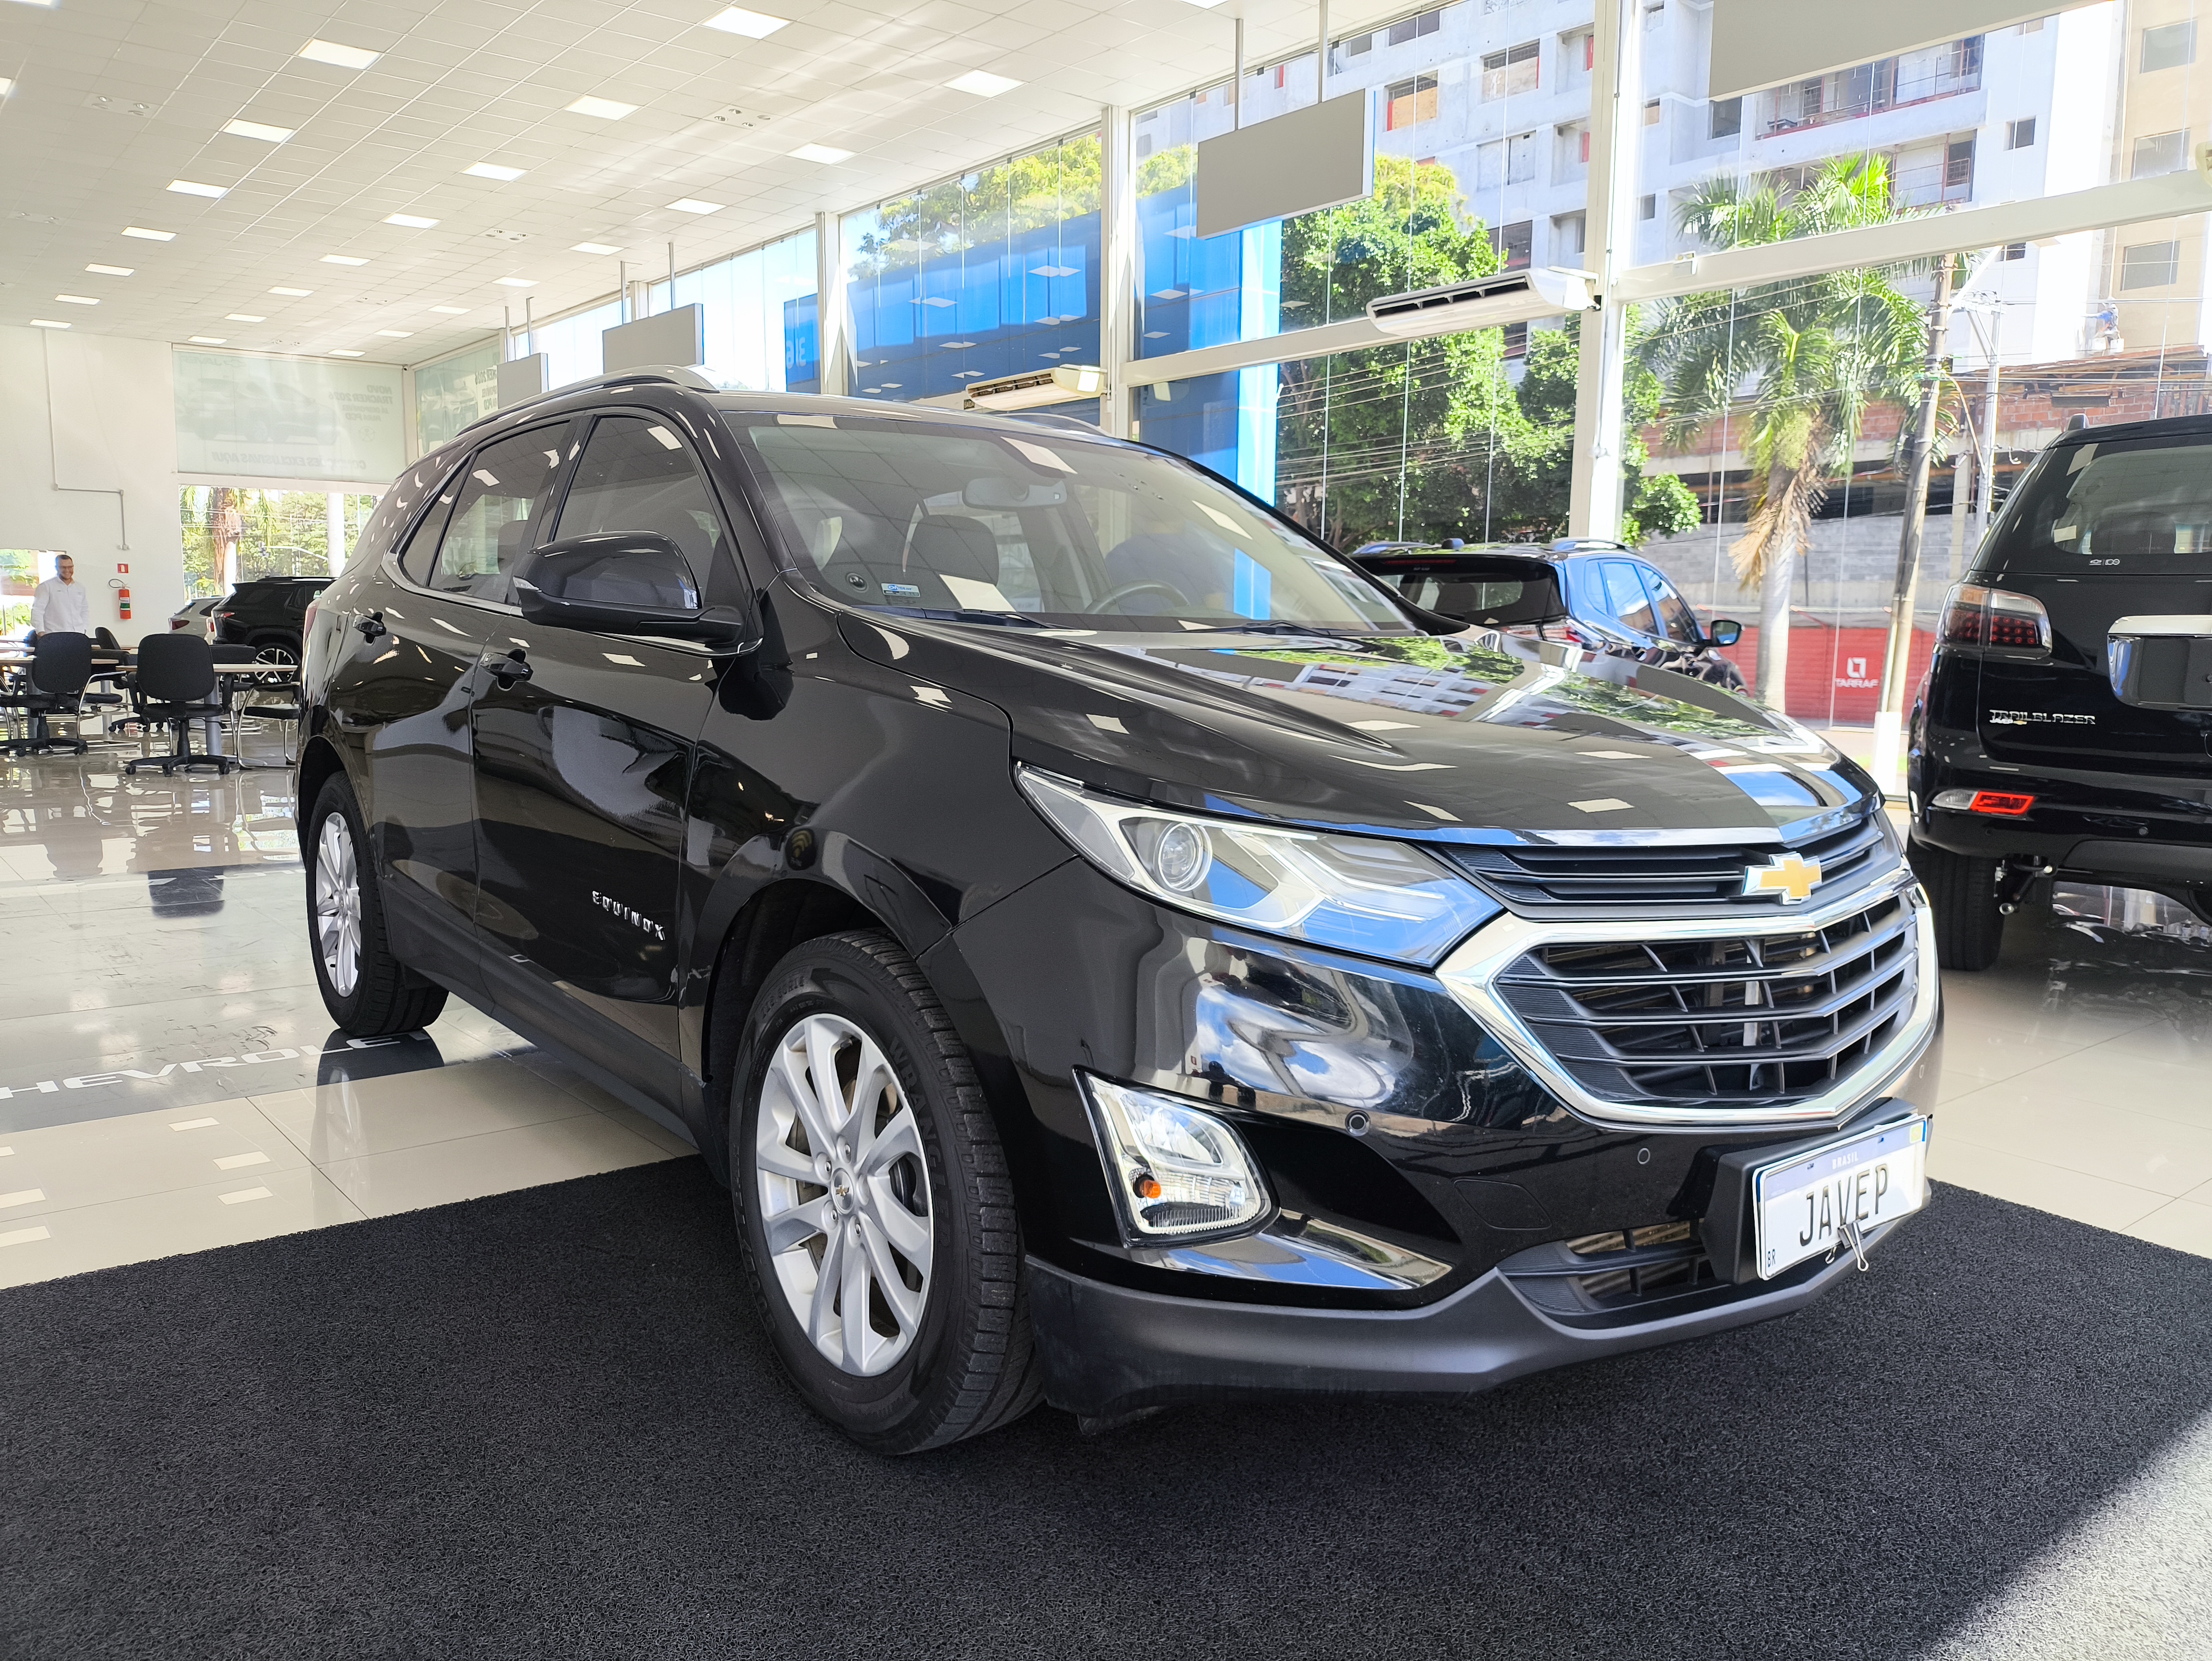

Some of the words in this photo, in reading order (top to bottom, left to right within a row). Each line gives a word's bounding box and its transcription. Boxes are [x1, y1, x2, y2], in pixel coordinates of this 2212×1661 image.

[1836, 678, 1879, 688] TARRAF
[1989, 709, 2096, 725] TRAILBLAZER
[592, 890, 666, 941] EQUINOX
[889, 1036, 951, 1247] WRANGLER
[1832, 1151, 1859, 1170] BRASIL
[1799, 1163, 1888, 1247] JAVEP
